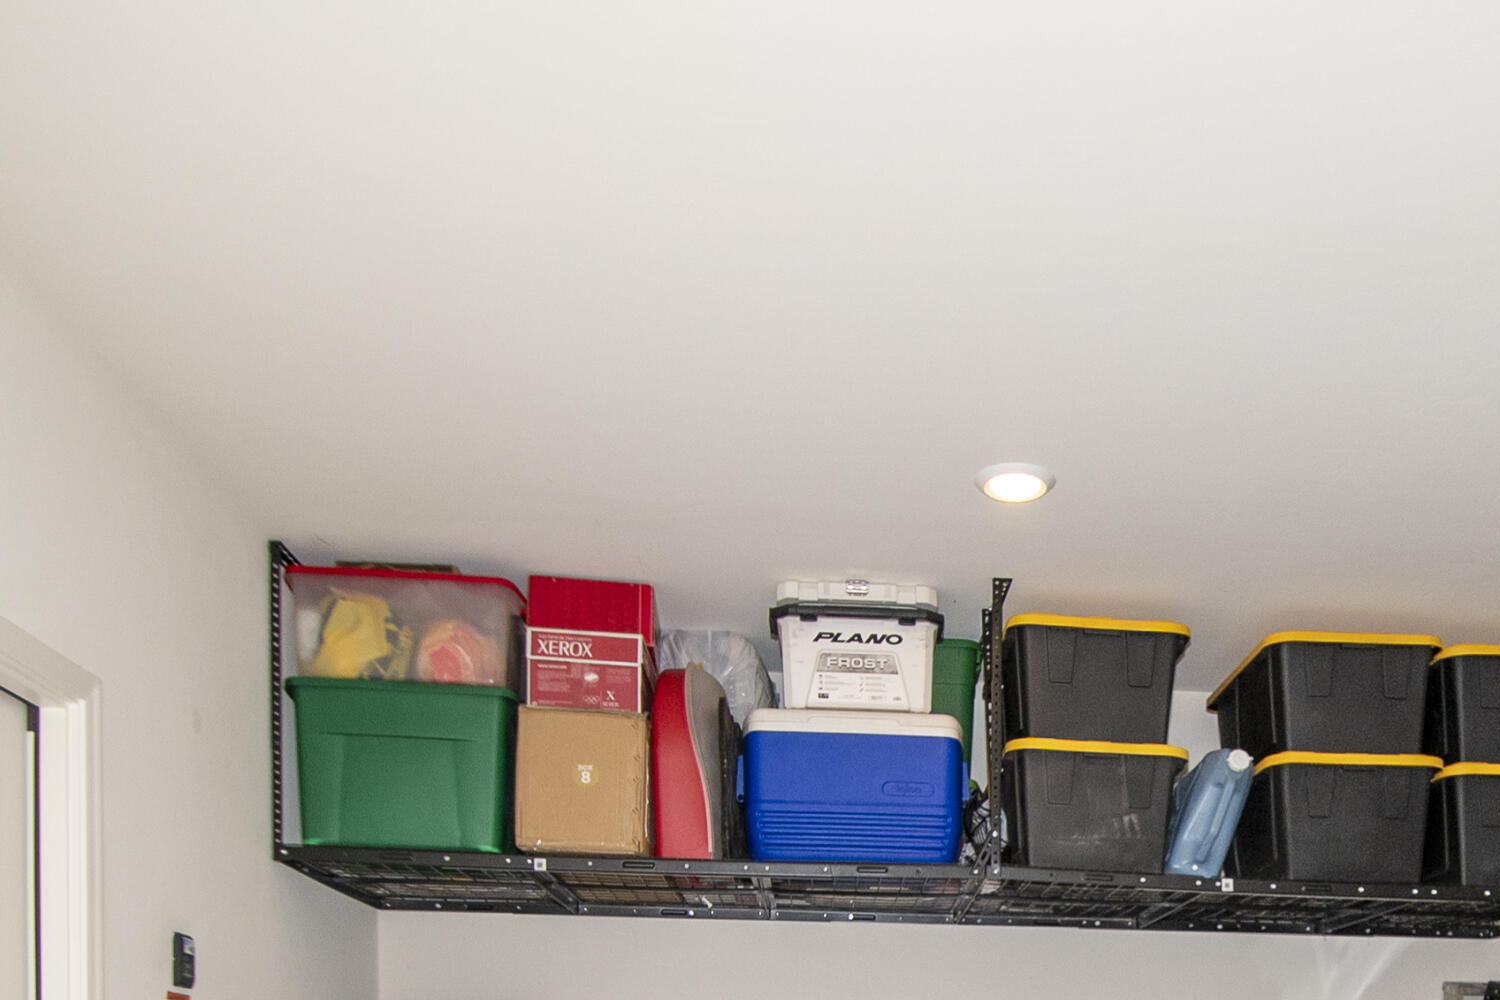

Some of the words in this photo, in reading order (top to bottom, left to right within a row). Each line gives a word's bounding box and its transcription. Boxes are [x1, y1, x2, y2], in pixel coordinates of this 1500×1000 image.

[813, 632, 903, 645] PLANO
[537, 638, 593, 658] XEROX
[826, 657, 888, 671] FROST
[581, 771, 591, 784] 8
